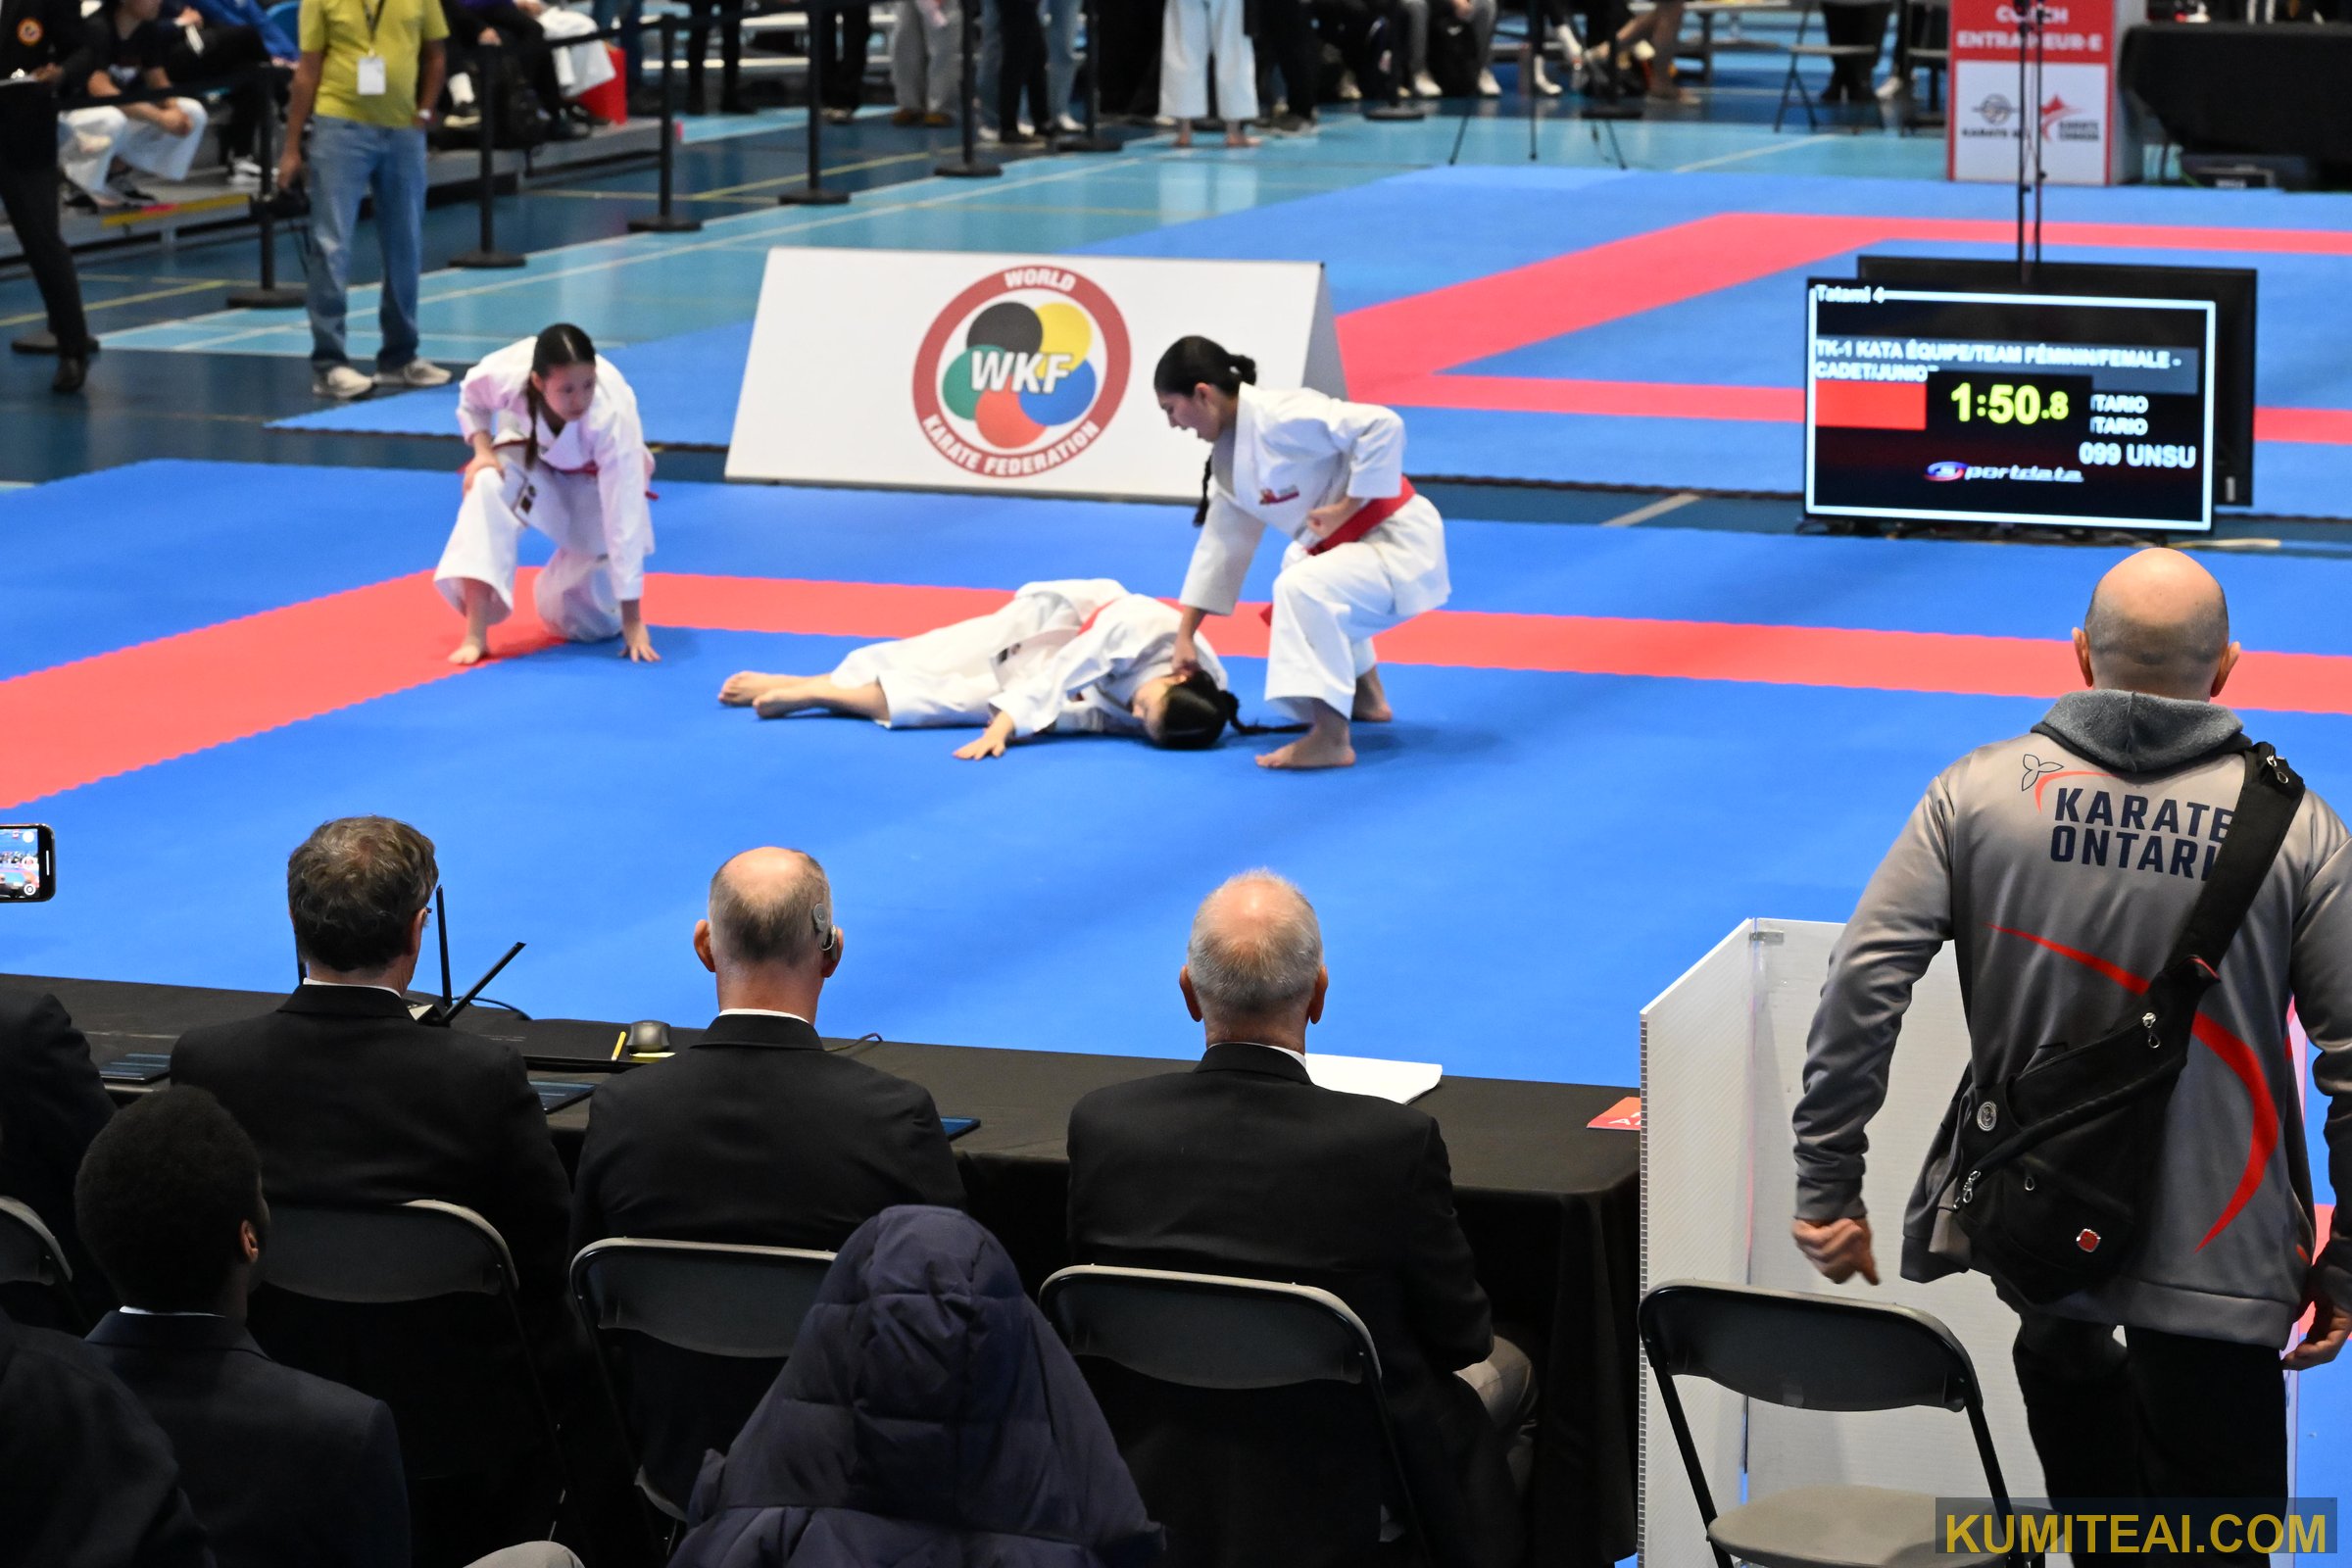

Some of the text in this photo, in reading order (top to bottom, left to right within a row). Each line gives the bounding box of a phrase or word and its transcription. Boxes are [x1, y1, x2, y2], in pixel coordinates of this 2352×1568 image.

[1004, 269, 1076, 291] WORLD
[1815, 285, 1871, 303] Tatami
[1816, 340, 1852, 357] TK-1
[1856, 341, 1903, 359] KATA
[971, 351, 1072, 393] WKF
[1815, 362, 1939, 382] CADET/JUNIO
[1951, 382, 2069, 424] 1:50.8
[922, 414, 1101, 476] KARATE FEDERATION
[2079, 441, 2196, 468] 099 UNSU
[2054, 787, 2235, 843] KARATE
[2050, 825, 2217, 881] ONTARI
